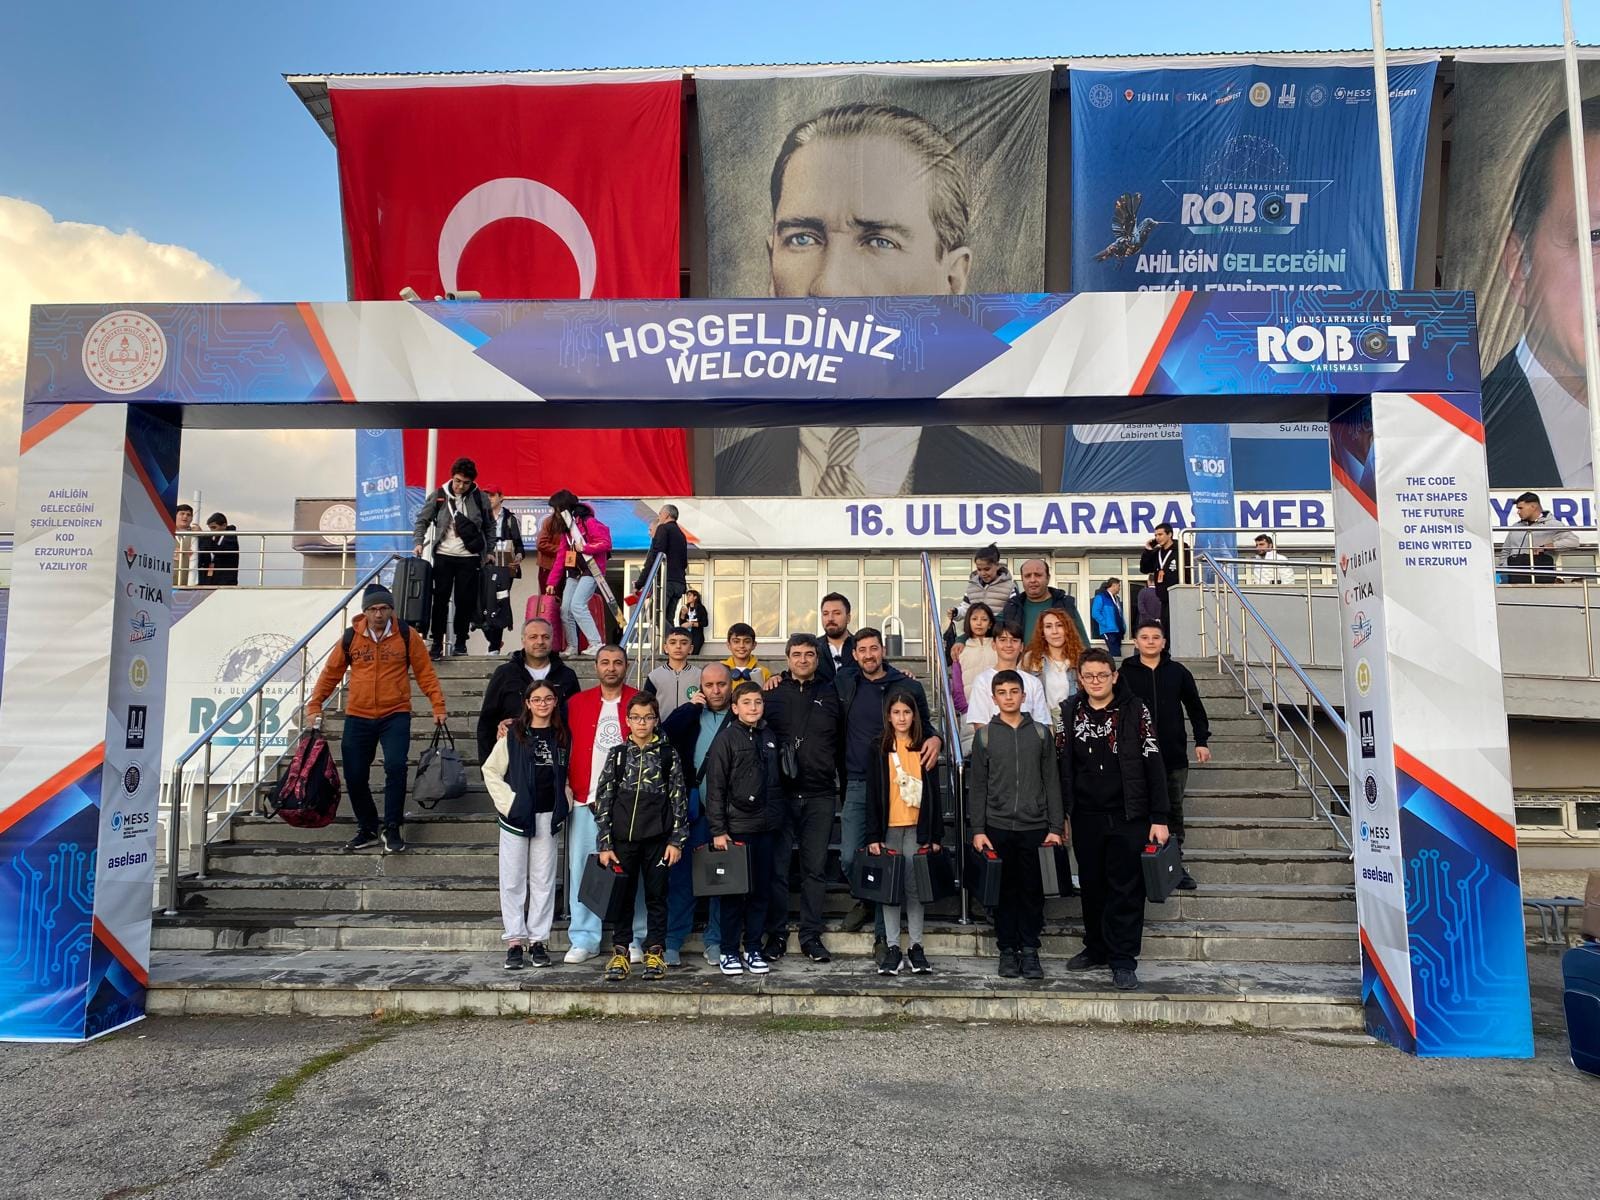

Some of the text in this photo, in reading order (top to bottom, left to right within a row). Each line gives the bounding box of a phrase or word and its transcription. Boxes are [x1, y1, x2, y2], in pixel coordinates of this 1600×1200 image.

[1186, 92, 1208, 101] TİKA
[1346, 89, 1372, 97] MESS
[1389, 89, 1417, 98] elsan
[1214, 183, 1271, 191] ULUSLARARASI
[1181, 192, 1309, 225] ROBOT
[1220, 225, 1261, 234] YARIŞMASI
[1135, 249, 1346, 273] AHİLİĞİN GELECEĞİNİ
[1279, 315, 1392, 324] 16. ULUSLARARASI MEB
[604, 307, 902, 363] HOŞGELDİNİZ
[1257, 325, 1416, 362] ROBOT
[665, 350, 843, 384] WELCOME
[1310, 364, 1363, 373] YARIŞMASI
[1279, 424, 1291, 432] Su
[1293, 424, 1309, 432] Altı
[1120, 430, 1159, 439] Labirent
[1406, 476, 1456, 486] THE CODE
[48, 488, 88, 499] AHİLİĞİN
[1396, 492, 1468, 502] THAT SHAPES
[40, 502, 95, 513] GELECEĞİNİ
[845, 497, 1597, 536] 16. ULUSLARARA MEB YRI
[1401, 508, 1465, 518] THE FUTURE
[30, 517, 103, 529] ŞEKİLLENDİREN
[1404, 524, 1465, 534] OF AHISM IS
[55, 533, 75, 542] KOD
[1398, 541, 1472, 550] BEING WRITED
[34, 547, 93, 556] ERZURUM'DA
[138, 553, 172, 574] TÜBİTAK
[1350, 547, 1377, 570] TÜBİTAK
[1405, 557, 1468, 566] IN ERZURUM
[39, 562, 88, 571] YAZILIYOR
[139, 583, 163, 604] TİKA
[1353, 582, 1374, 603] TİKA
[213, 687, 226, 695] 16.
[238, 736, 287, 747] YARŞMASI
[123, 812, 149, 825] MESS
[1369, 826, 1390, 840] MESS
[108, 851, 147, 869] aselsan
[1362, 866, 1394, 884] aselsan
